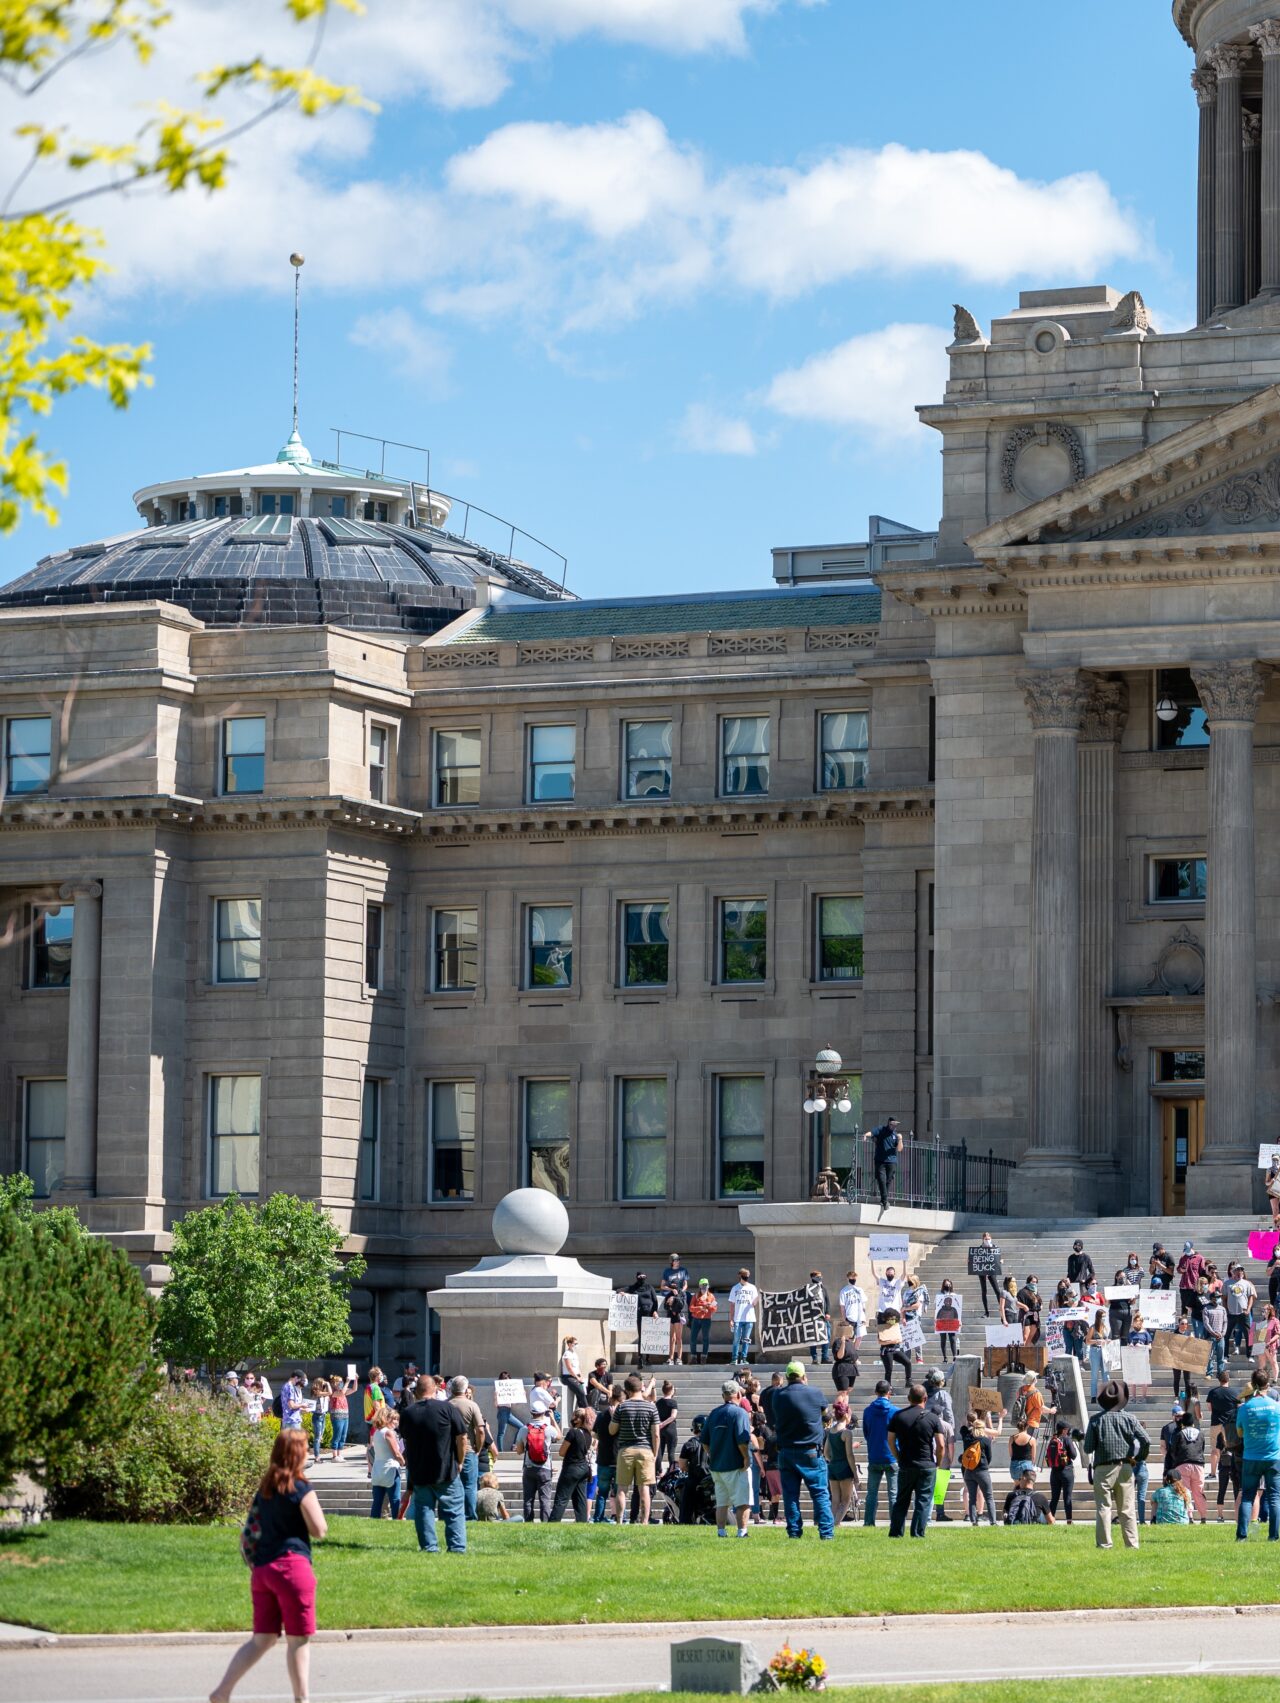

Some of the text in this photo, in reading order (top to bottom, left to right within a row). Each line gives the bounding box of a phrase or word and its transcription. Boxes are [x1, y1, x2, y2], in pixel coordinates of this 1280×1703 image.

[970, 1247, 1000, 1255] LEGALIZE
[973, 1255, 994, 1263] BEING
[972, 1263, 995, 1271] BLACK
[763, 1283, 817, 1308] BLACK
[767, 1300, 825, 1327] LIVES
[761, 1320, 828, 1346] MATTER
[676, 1648, 735, 1663] DESERT STORM
